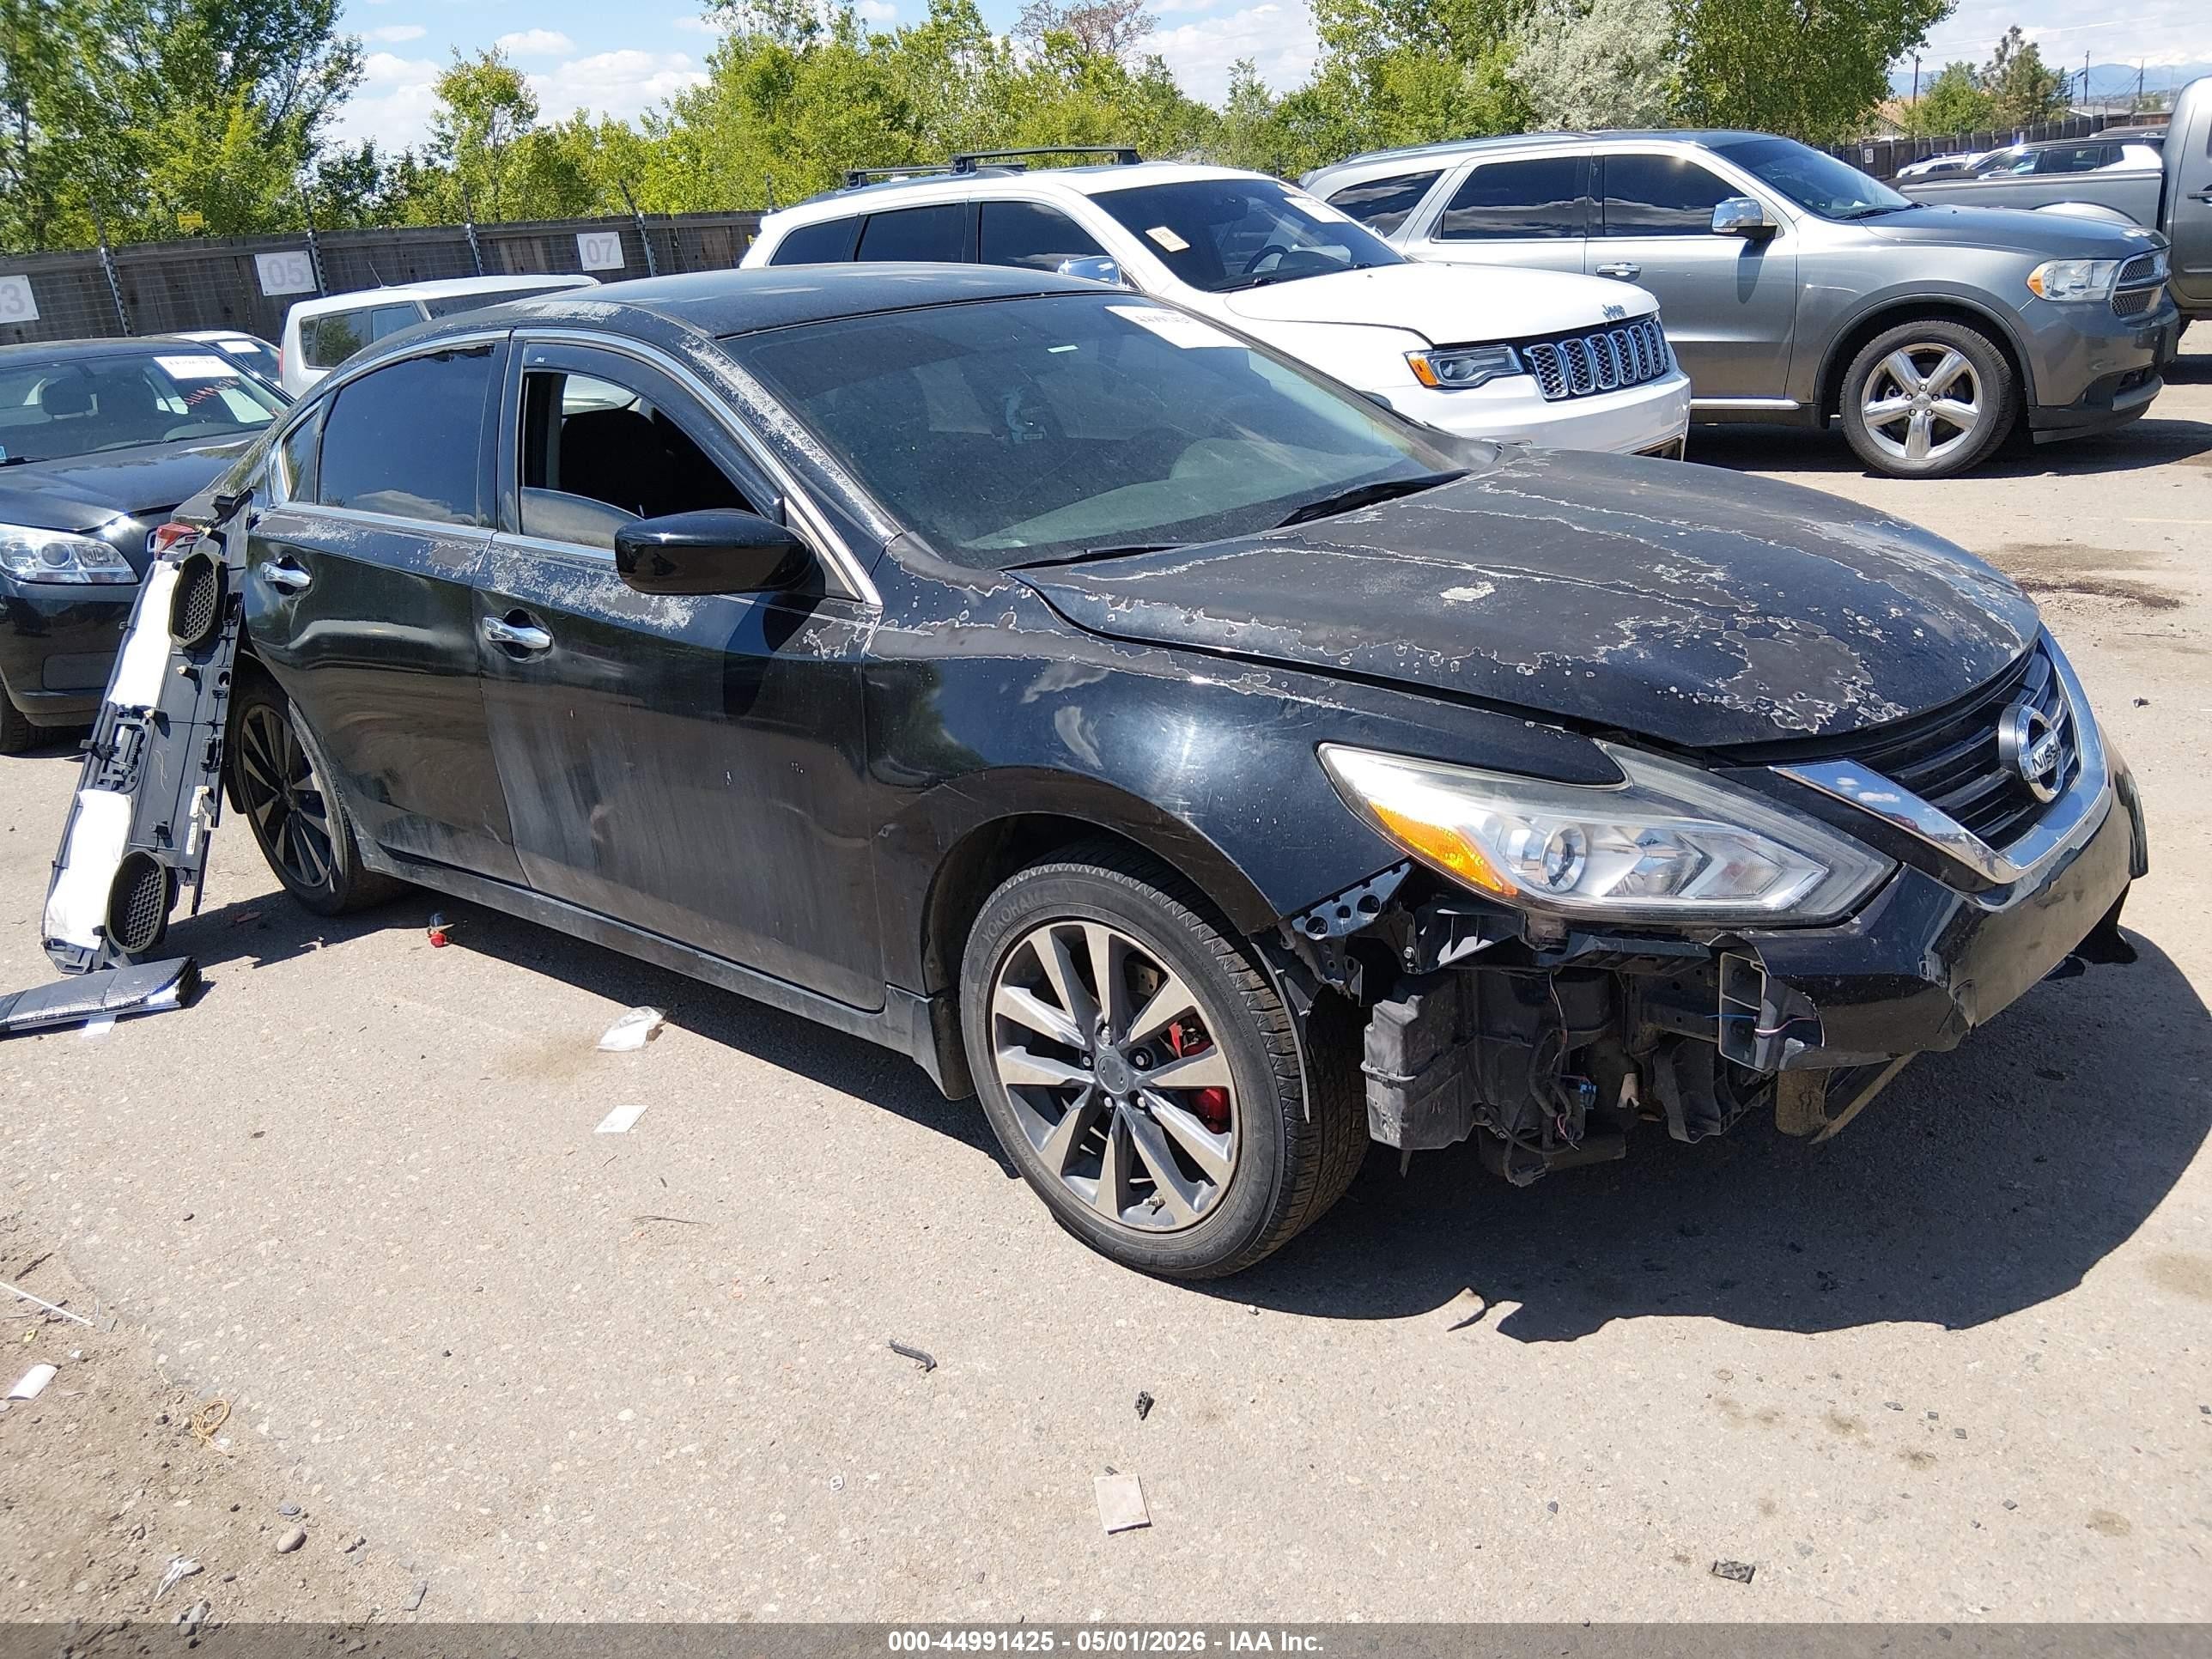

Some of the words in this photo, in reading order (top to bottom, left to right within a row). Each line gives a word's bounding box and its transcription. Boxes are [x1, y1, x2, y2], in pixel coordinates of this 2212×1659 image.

[586, 239, 614, 264] 07
[267, 258, 306, 289] 05
[0, 283, 26, 315] 3
